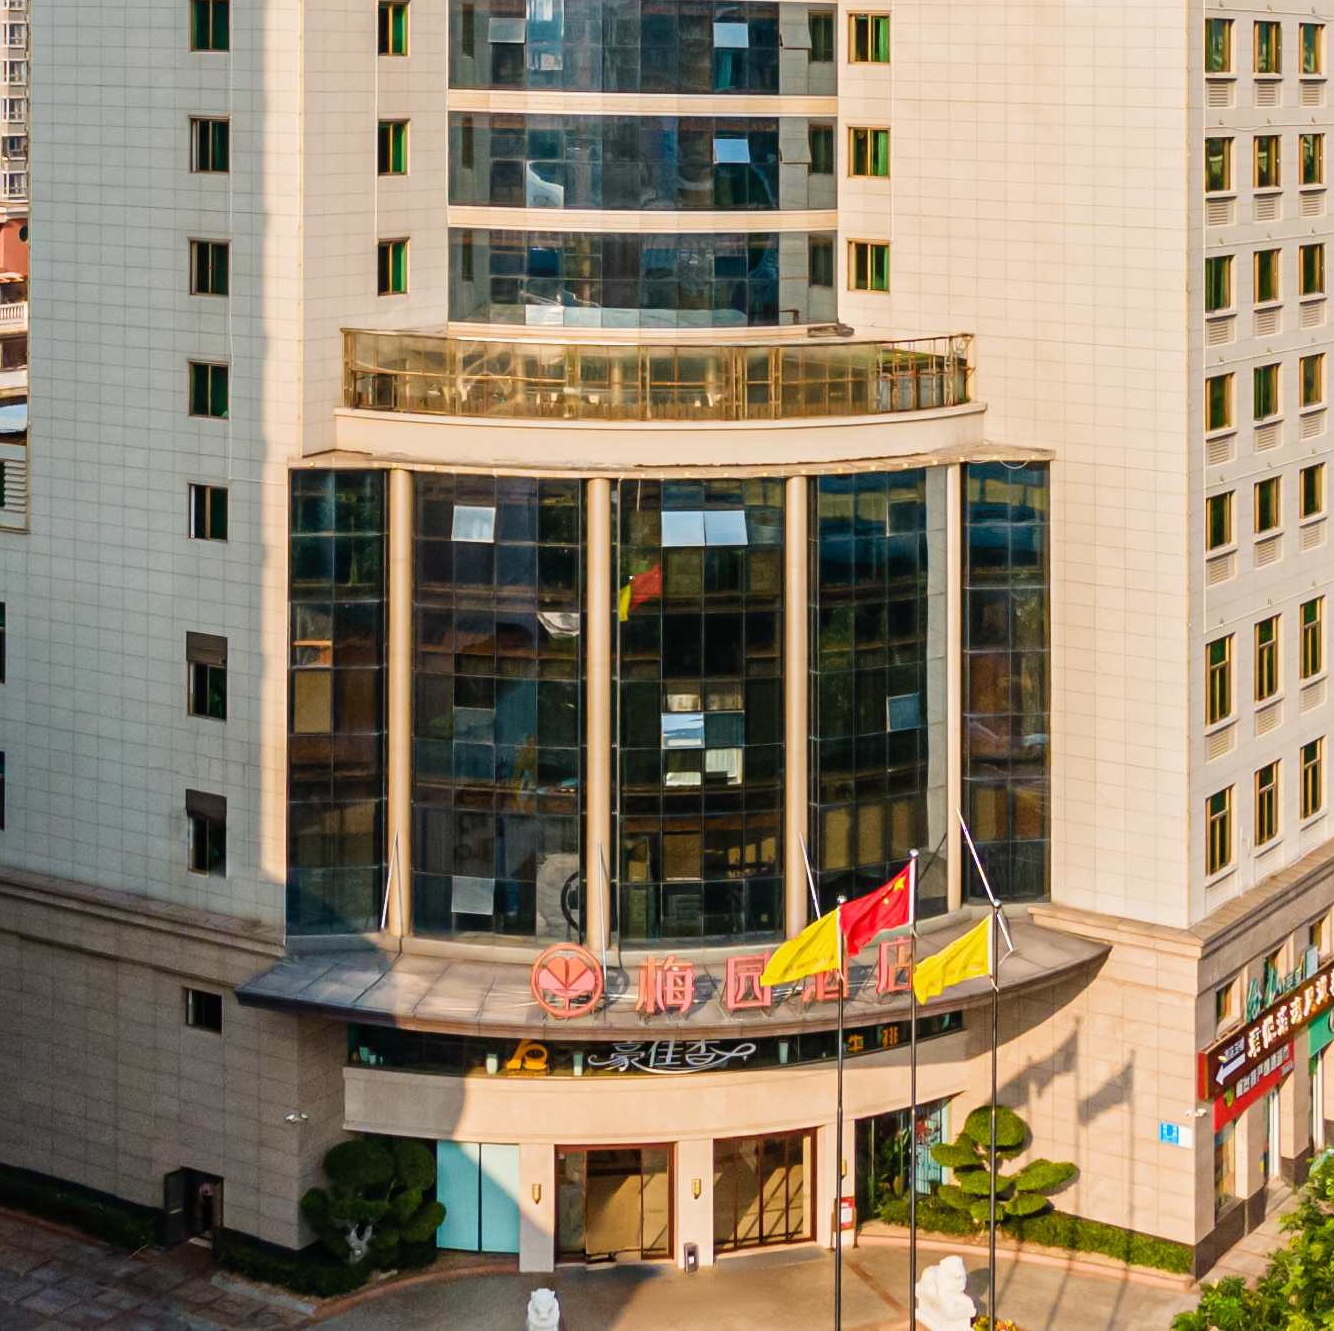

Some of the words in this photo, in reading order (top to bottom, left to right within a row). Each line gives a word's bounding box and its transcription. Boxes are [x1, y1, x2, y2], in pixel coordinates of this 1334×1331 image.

[588, 1039, 757, 1074] 豪佳香
[847, 1026, 899, 1054] 牛排
